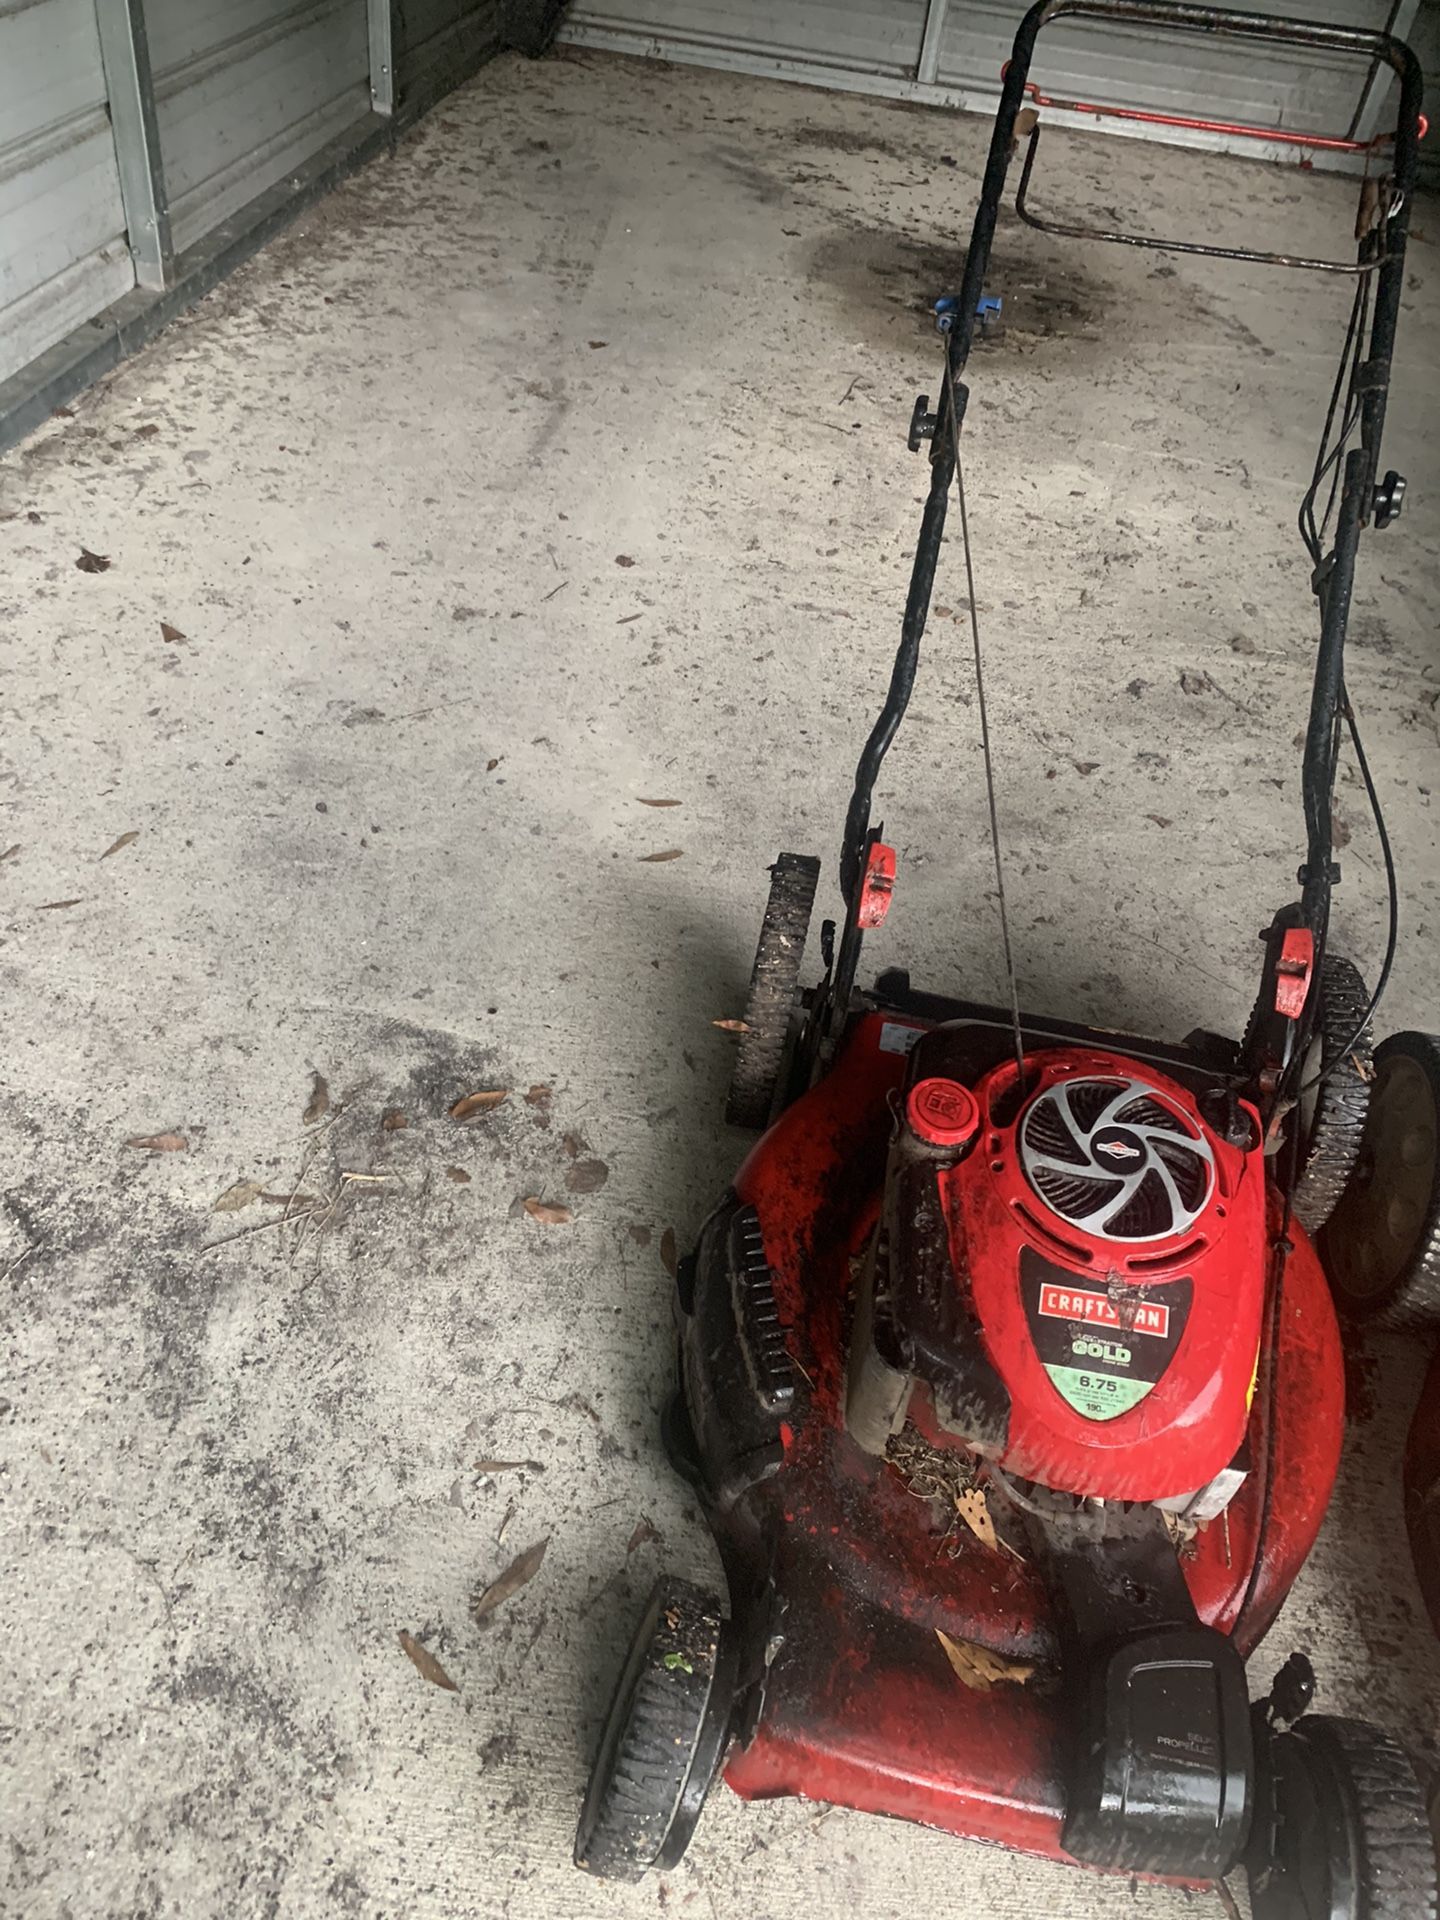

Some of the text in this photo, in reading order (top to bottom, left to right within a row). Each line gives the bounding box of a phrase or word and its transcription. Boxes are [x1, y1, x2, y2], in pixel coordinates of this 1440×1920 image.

[1047, 1292, 1159, 1327] CRAFTSAN
[1072, 1340, 1132, 1363] GOLD
[1079, 1375, 1118, 1392] 6.75
[1156, 1736, 1216, 1756] PROPELLE
